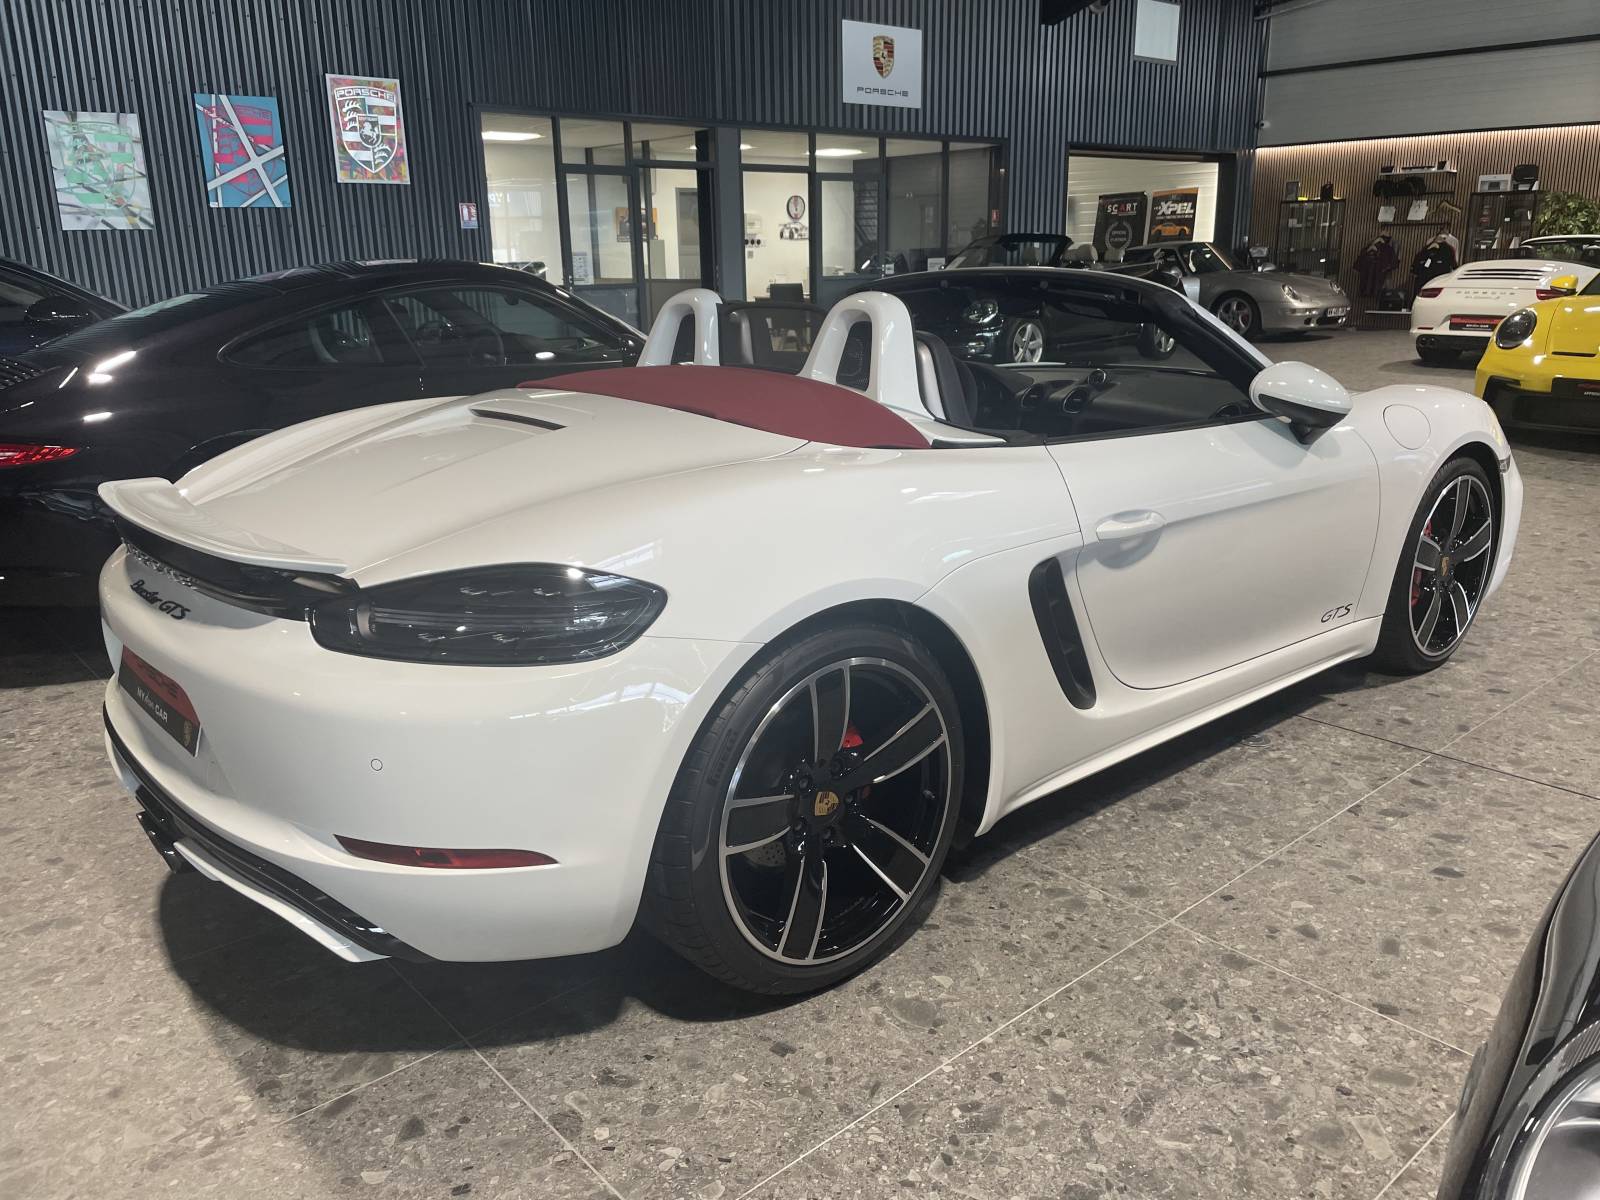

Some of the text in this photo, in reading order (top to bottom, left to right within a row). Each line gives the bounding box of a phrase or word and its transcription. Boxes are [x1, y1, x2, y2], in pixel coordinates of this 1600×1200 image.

[335, 87, 395, 100] PORSCHE
[856, 86, 909, 97] PORSCHE
[1156, 200, 1195, 216] XPEL
[158, 600, 191, 620] GTS
[1320, 603, 1353, 623] GTS
